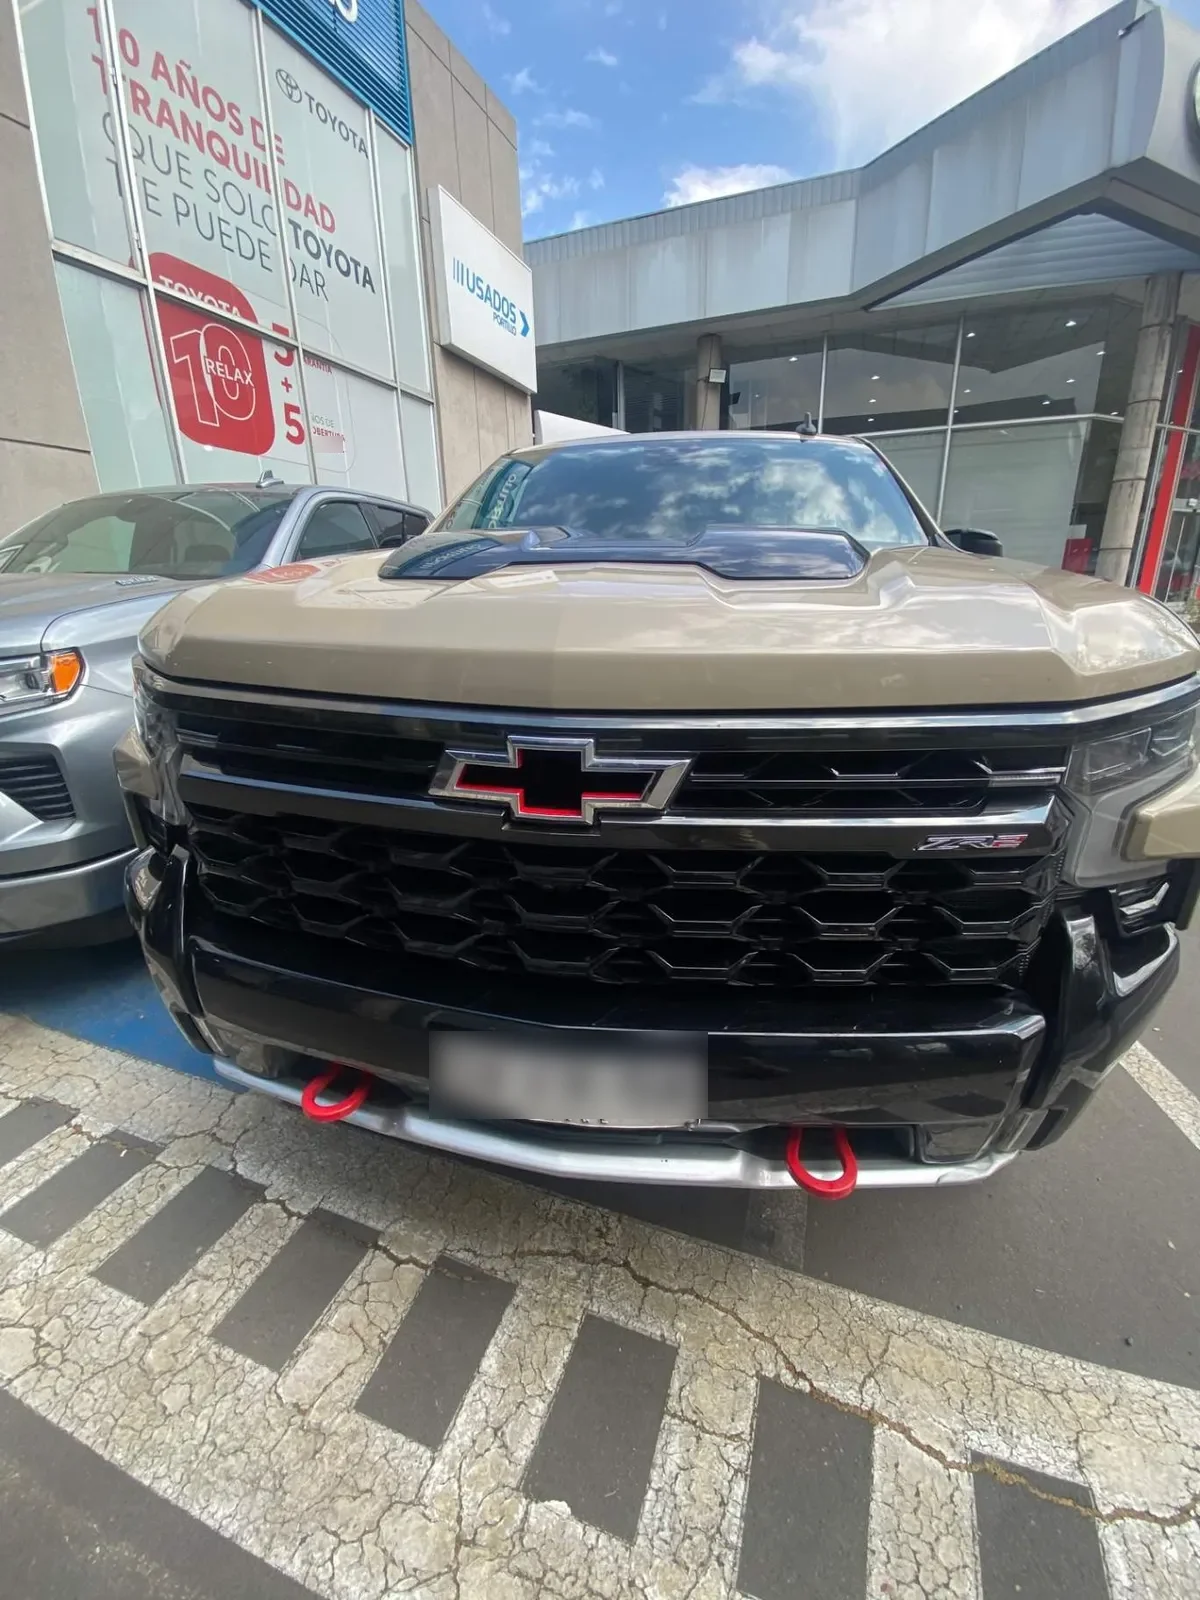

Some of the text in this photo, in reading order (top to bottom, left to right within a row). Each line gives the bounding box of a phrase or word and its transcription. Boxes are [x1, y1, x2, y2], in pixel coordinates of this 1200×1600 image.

[87, 8, 285, 166] 10 AÑOS DE
[304, 91, 369, 159] TOYOTA
[102, 112, 194, 190] QUE
[288, 218, 376, 294] TOYOTA
[106, 157, 162, 217] TE
[172, 193, 273, 272] PUEDE
[466, 267, 516, 324] USADOS
[205, 358, 255, 387] RELAX
[284, 402, 306, 445] 5
